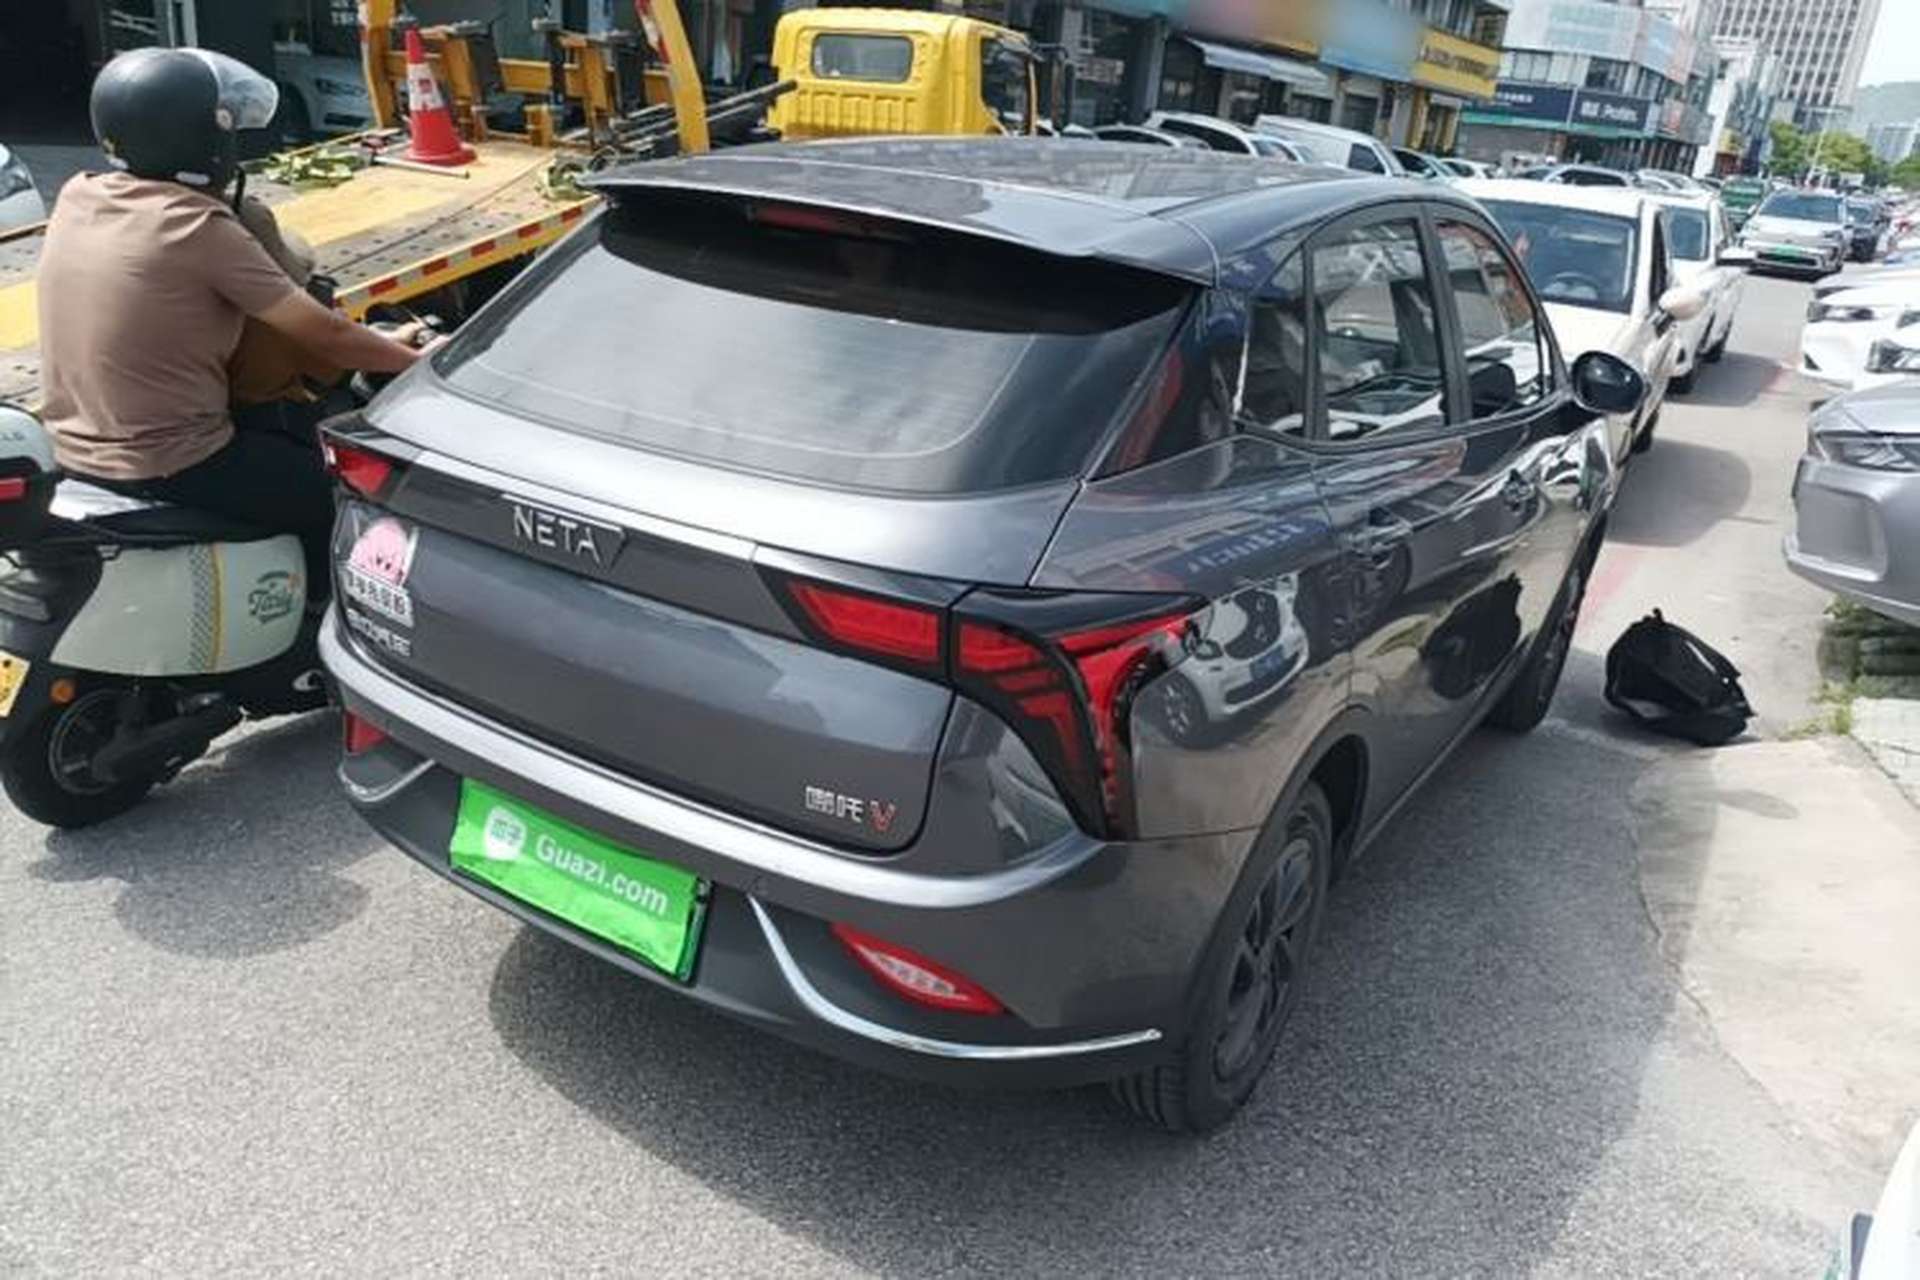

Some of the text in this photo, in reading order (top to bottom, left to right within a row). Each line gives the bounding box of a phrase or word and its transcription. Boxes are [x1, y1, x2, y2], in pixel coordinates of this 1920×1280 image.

[513, 504, 601, 566] NETA
[869, 798, 897, 832] V
[535, 834, 670, 915] Guazi.com
